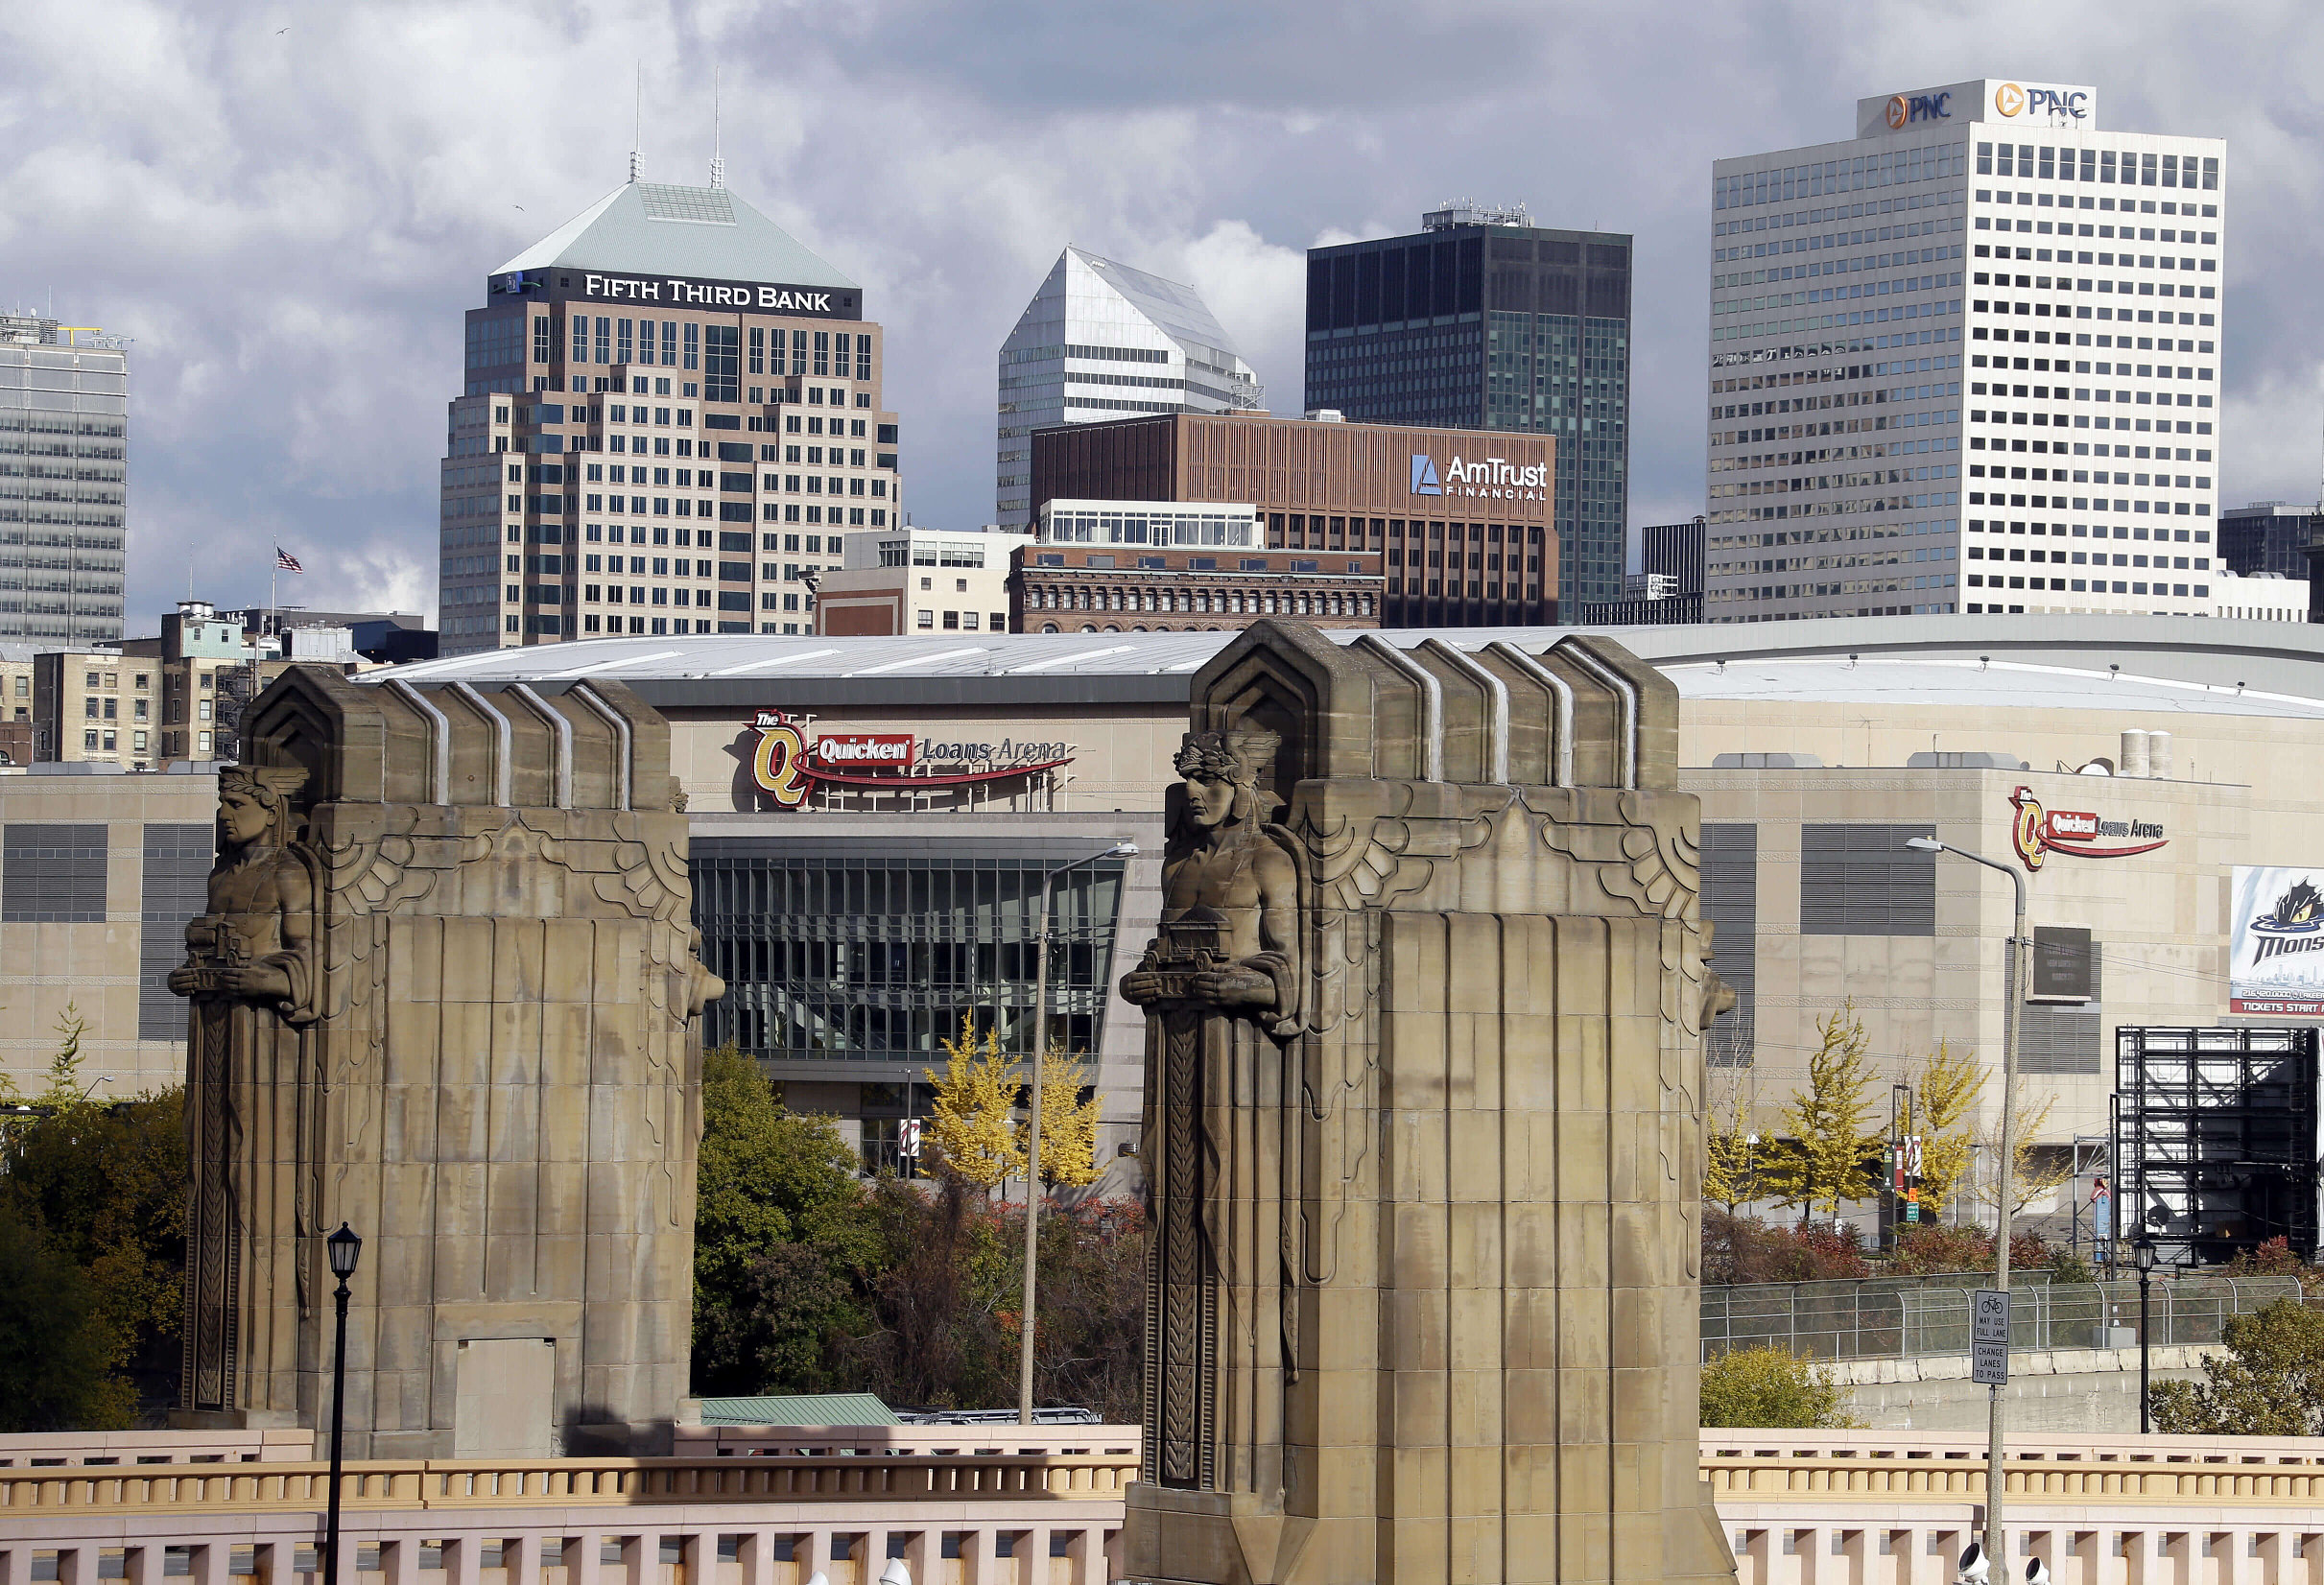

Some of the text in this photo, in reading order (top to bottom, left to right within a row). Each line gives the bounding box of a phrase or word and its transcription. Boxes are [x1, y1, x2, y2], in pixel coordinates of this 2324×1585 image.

[1908, 92, 1952, 123] PNC
[2027, 88, 2088, 119] PNC
[585, 273, 831, 312] FIFTH THIRD BANK
[1445, 456, 1548, 487] AmTrust
[1446, 485, 1547, 501] FINANCIAL
[756, 712, 779, 726] The
[819, 737, 1067, 764] Quicken Loans Arena
[2051, 814, 2164, 839] Quicken Loans Arena
[2241, 1002, 2284, 1012] TICKETS
[2287, 1003, 2318, 1013] START
[1994, 1317, 2004, 1326] USE
[1977, 1327, 2006, 1337] FULL LANE
[1978, 1347, 2004, 1357] CHANGE
[1980, 1359, 2001, 1367] LANES
[1976, 1369, 2004, 1380] TO PASS
